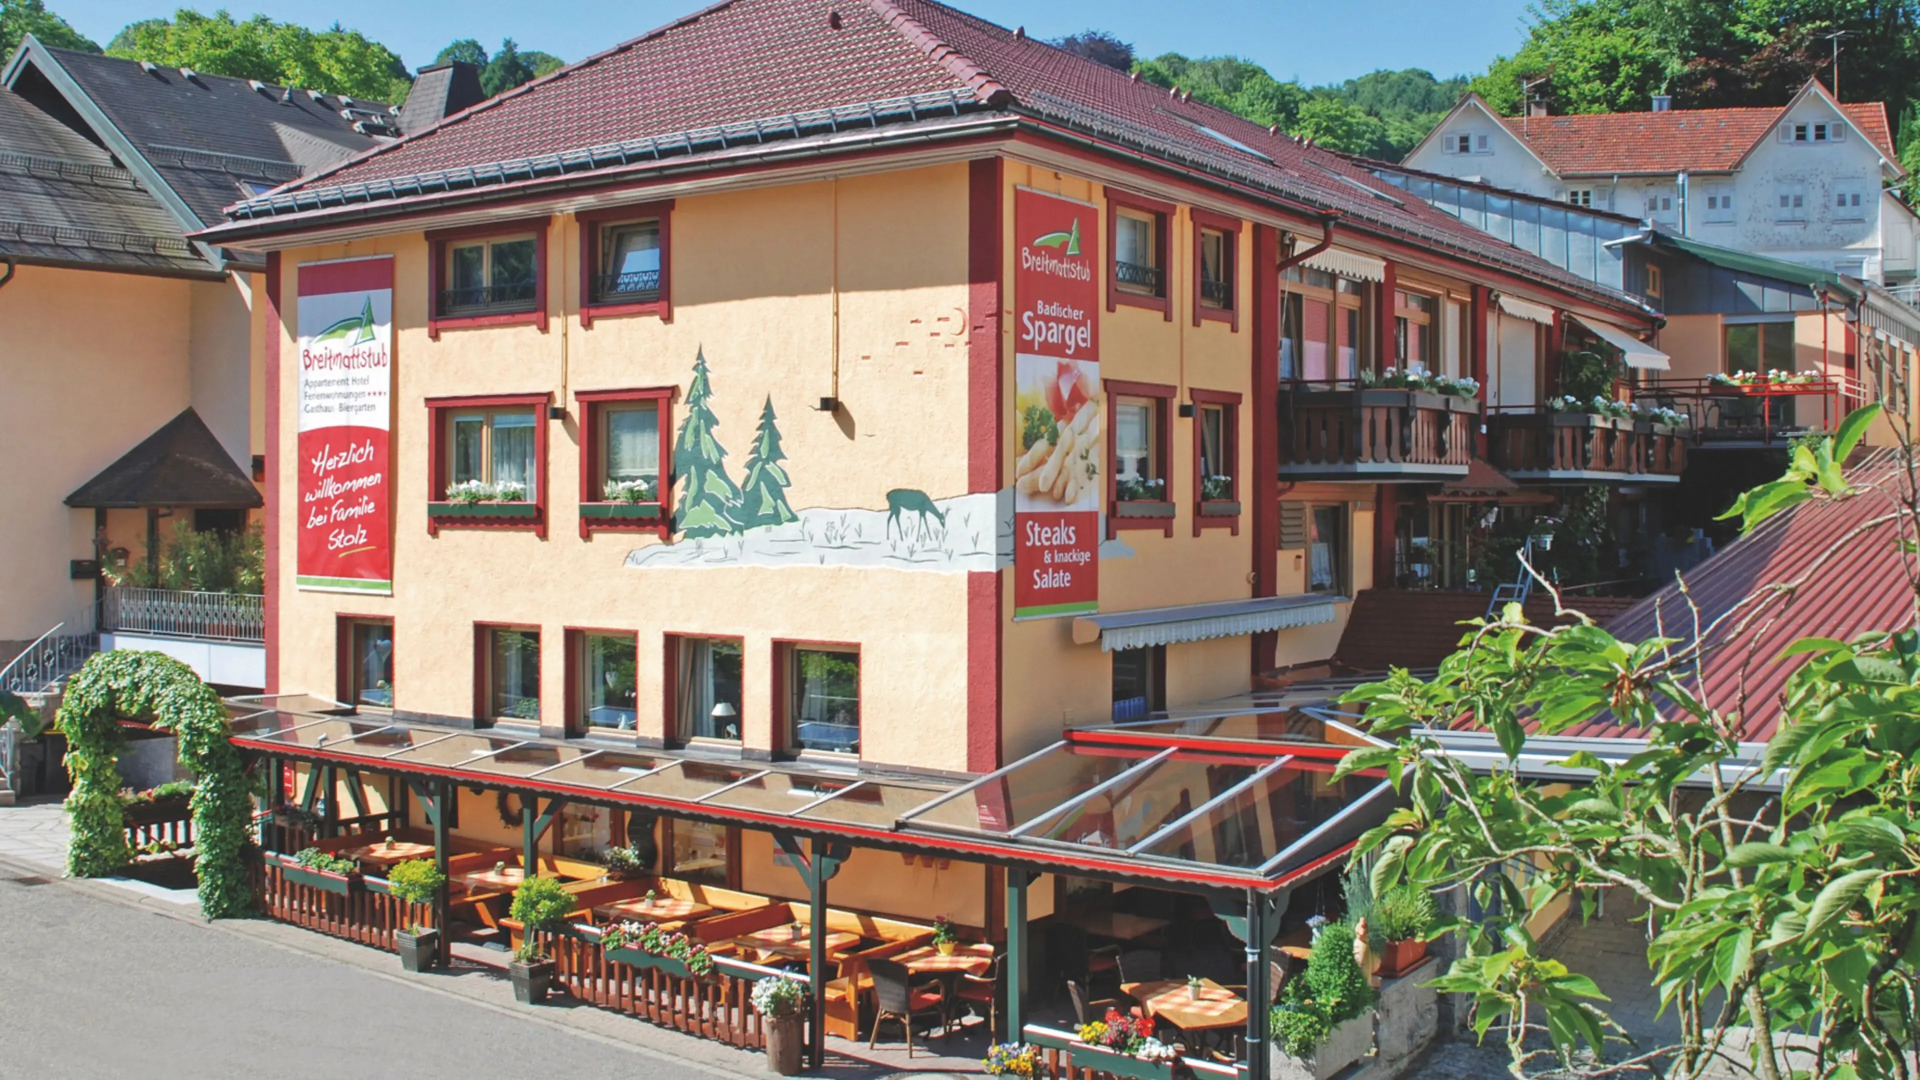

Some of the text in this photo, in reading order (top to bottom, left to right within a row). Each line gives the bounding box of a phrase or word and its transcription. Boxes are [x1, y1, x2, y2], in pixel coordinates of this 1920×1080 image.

[1021, 246, 1091, 282] Breitmattstub
[1037, 300, 1084, 320] Badischer
[1021, 311, 1091, 355] Spargel
[303, 342, 388, 371] Breitmattstub
[351, 376, 370, 386] Hotel
[304, 391, 366, 402] Ferienwohnungen
[304, 402, 376, 415] Gasthaus Biergarten
[311, 439, 374, 477] Herzlich
[304, 473, 382, 503] willkommen
[306, 495, 376, 529] bei Familie
[327, 523, 368, 550] Stolz
[1025, 518, 1076, 547] Steaks
[1043, 548, 1091, 566] & knackige
[1033, 567, 1071, 590] Salate
